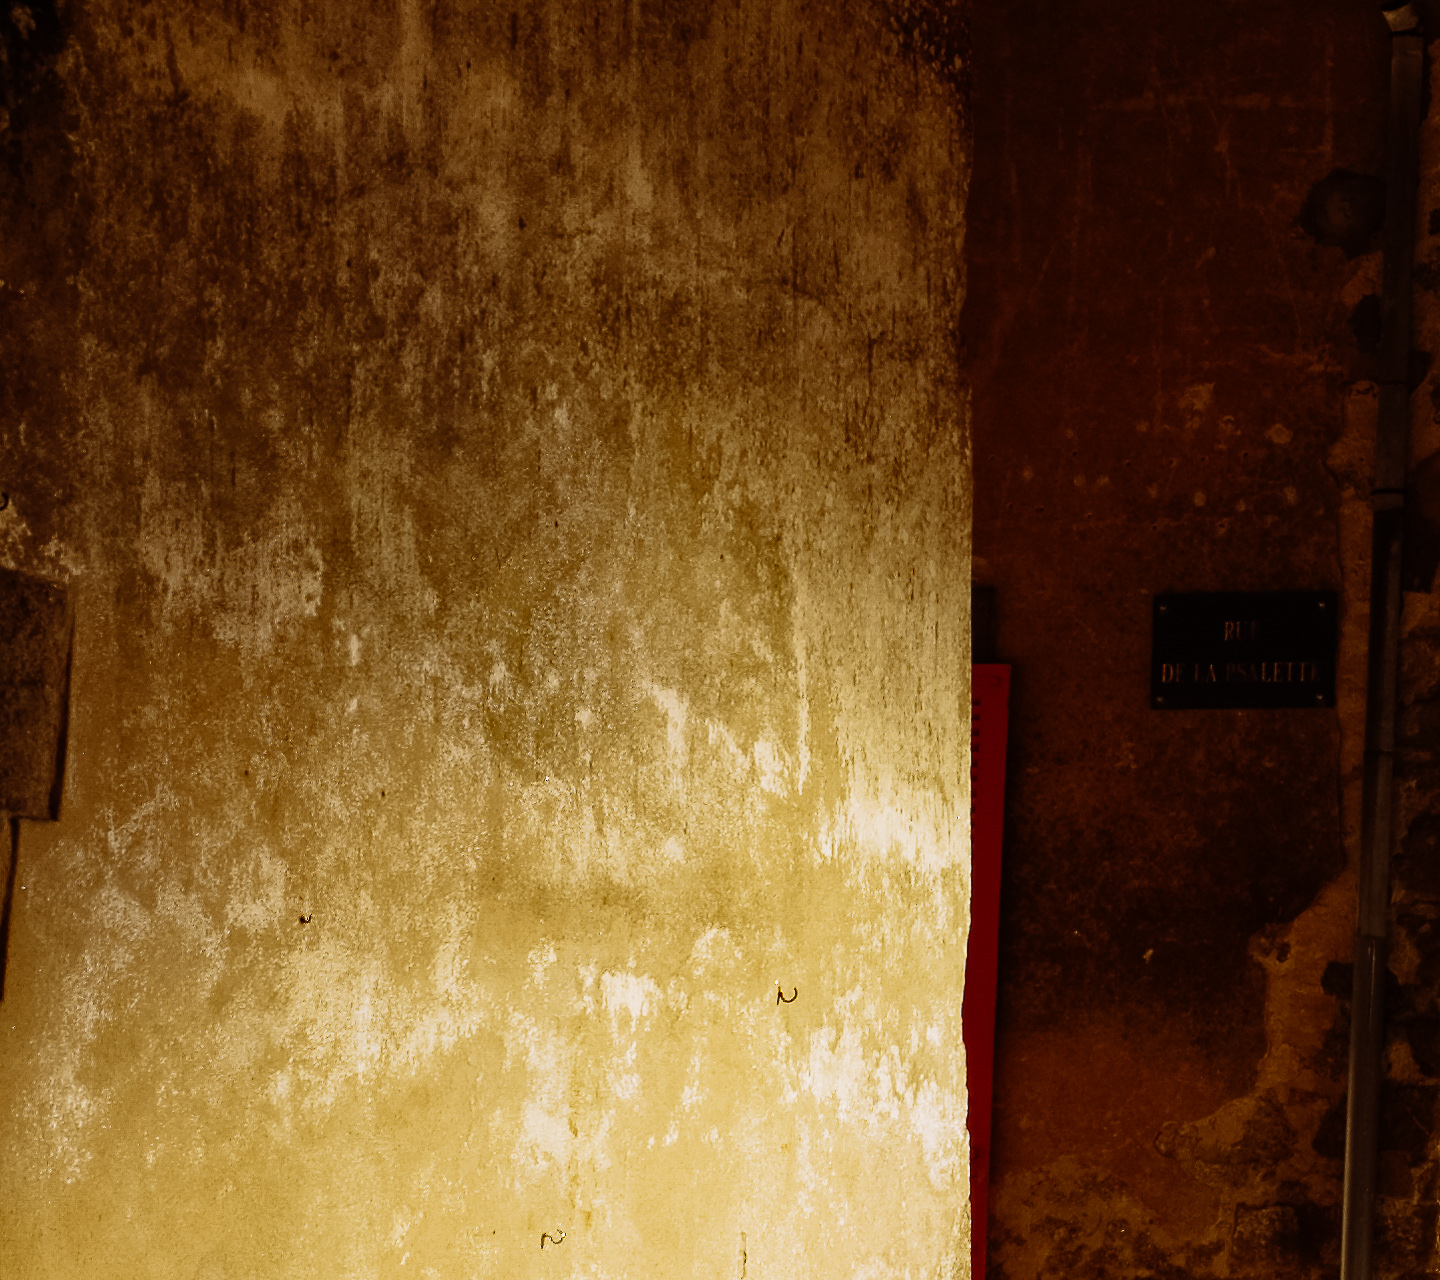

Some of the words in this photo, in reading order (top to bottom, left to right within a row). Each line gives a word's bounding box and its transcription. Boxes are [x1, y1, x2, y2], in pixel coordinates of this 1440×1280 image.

[1224, 621, 1261, 640] RUE
[1161, 663, 1185, 683] DE
[1192, 663, 1216, 683] LA
[1225, 661, 1320, 683] PSALETTE
